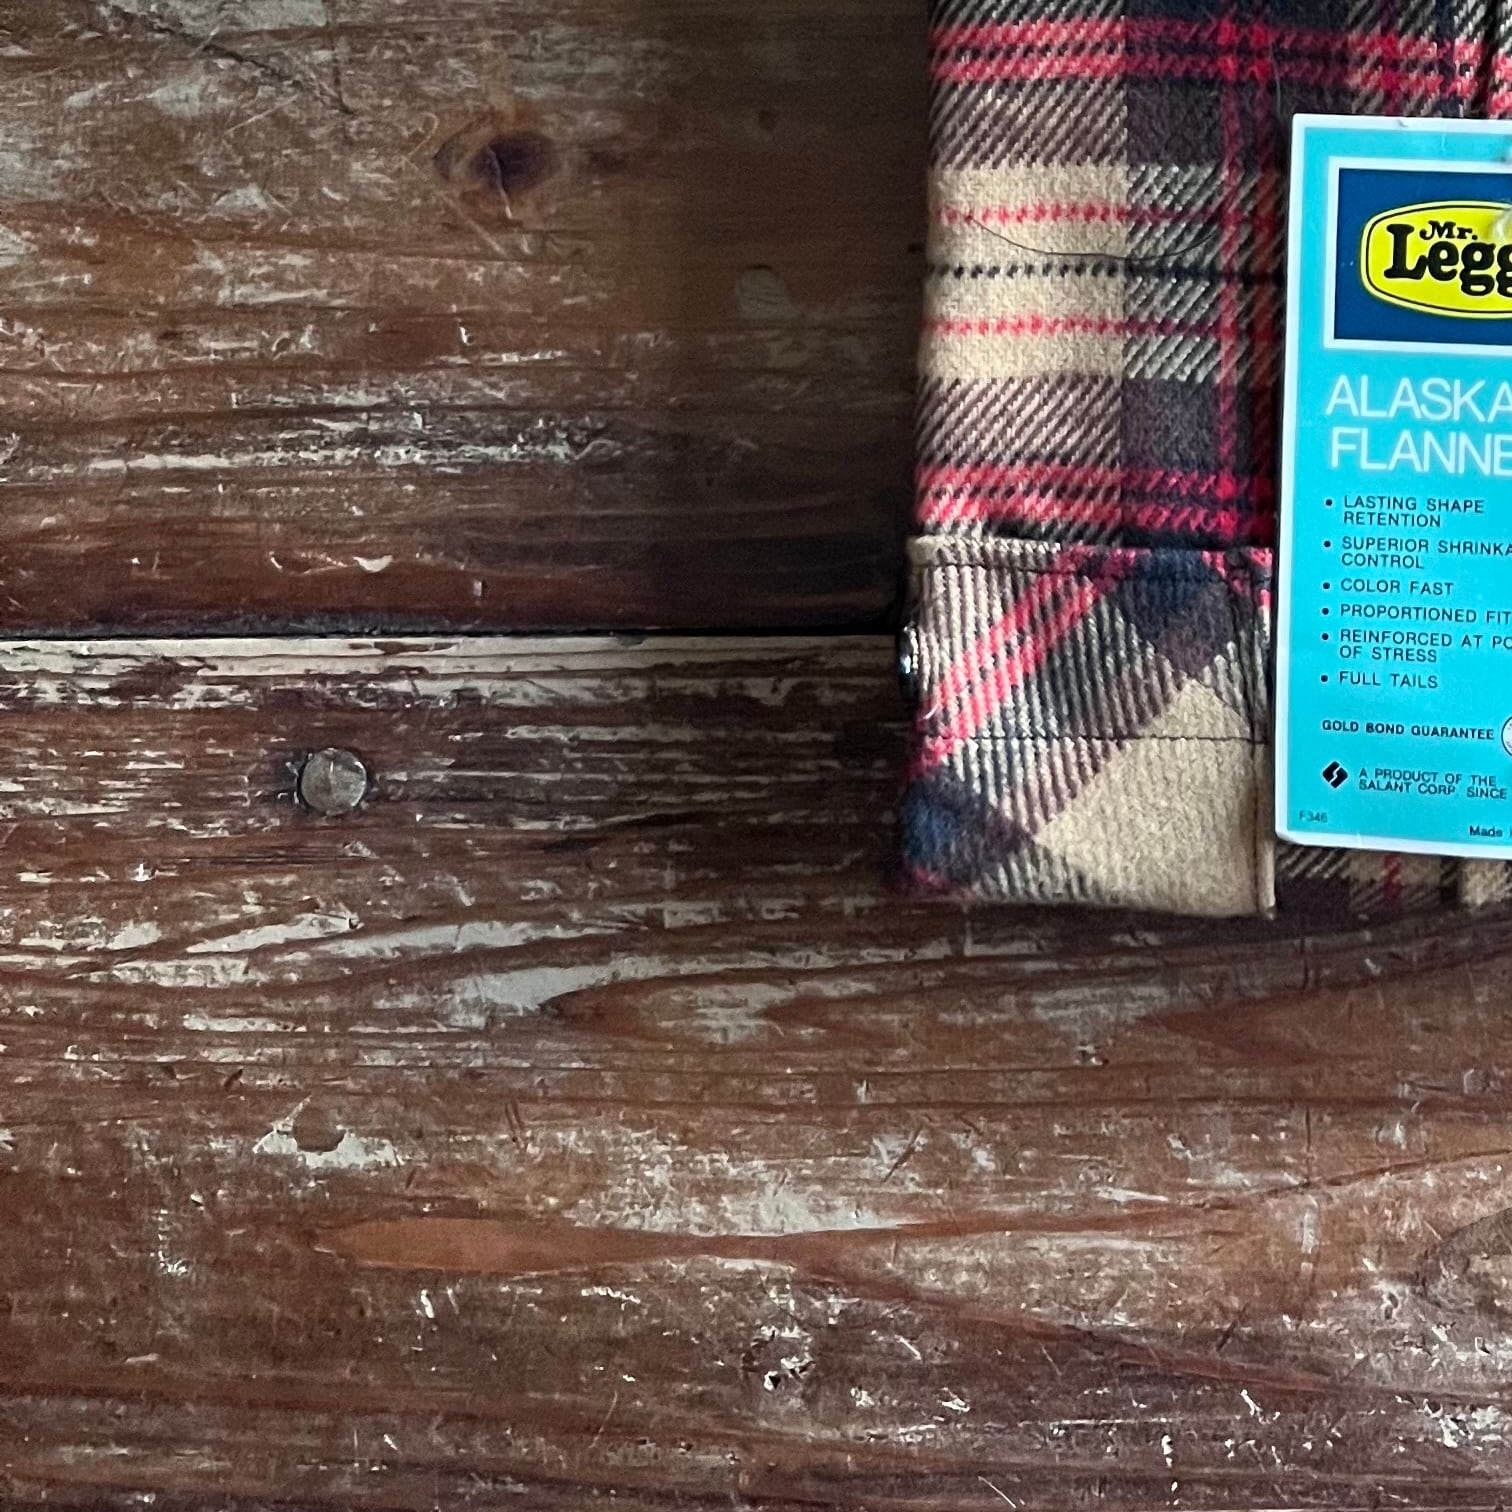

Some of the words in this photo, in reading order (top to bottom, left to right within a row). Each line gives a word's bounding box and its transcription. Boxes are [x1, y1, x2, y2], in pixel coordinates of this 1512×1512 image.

[1419, 220, 1478, 241] Mr.
[1343, 495, 1418, 511] LASTING
[1426, 499, 1485, 513] SHAPE
[1343, 512, 1441, 528] RETENTION
[1341, 537, 1429, 553] SUPERIOR
[1340, 553, 1425, 569] CONTROL
[1340, 579, 1401, 593] COLOR
[1410, 582, 1455, 596] FAST
[1340, 604, 1477, 623] PROPORTIONED
[1486, 611, 1512, 625] FIT
[1340, 629, 1453, 647] REINFORCED
[1461, 634, 1483, 649] AT
[1339, 646, 1362, 660] OF
[1371, 647, 1438, 663] STRESS
[1339, 671, 1382, 686] FULL
[1390, 674, 1439, 689] TAILS
[1322, 720, 1359, 733] GOLD
[1365, 722, 1405, 735] BOND
[1411, 724, 1495, 740] GUARANTEE
[1359, 767, 1368, 778] A
[1375, 768, 1439, 783] PRODUCT
[1445, 773, 1463, 784] OF
[1471, 774, 1497, 787] THE
[1358, 779, 1413, 792] SALANT
[1466, 786, 1507, 801] SINCE
[1469, 825, 1503, 838] Made
